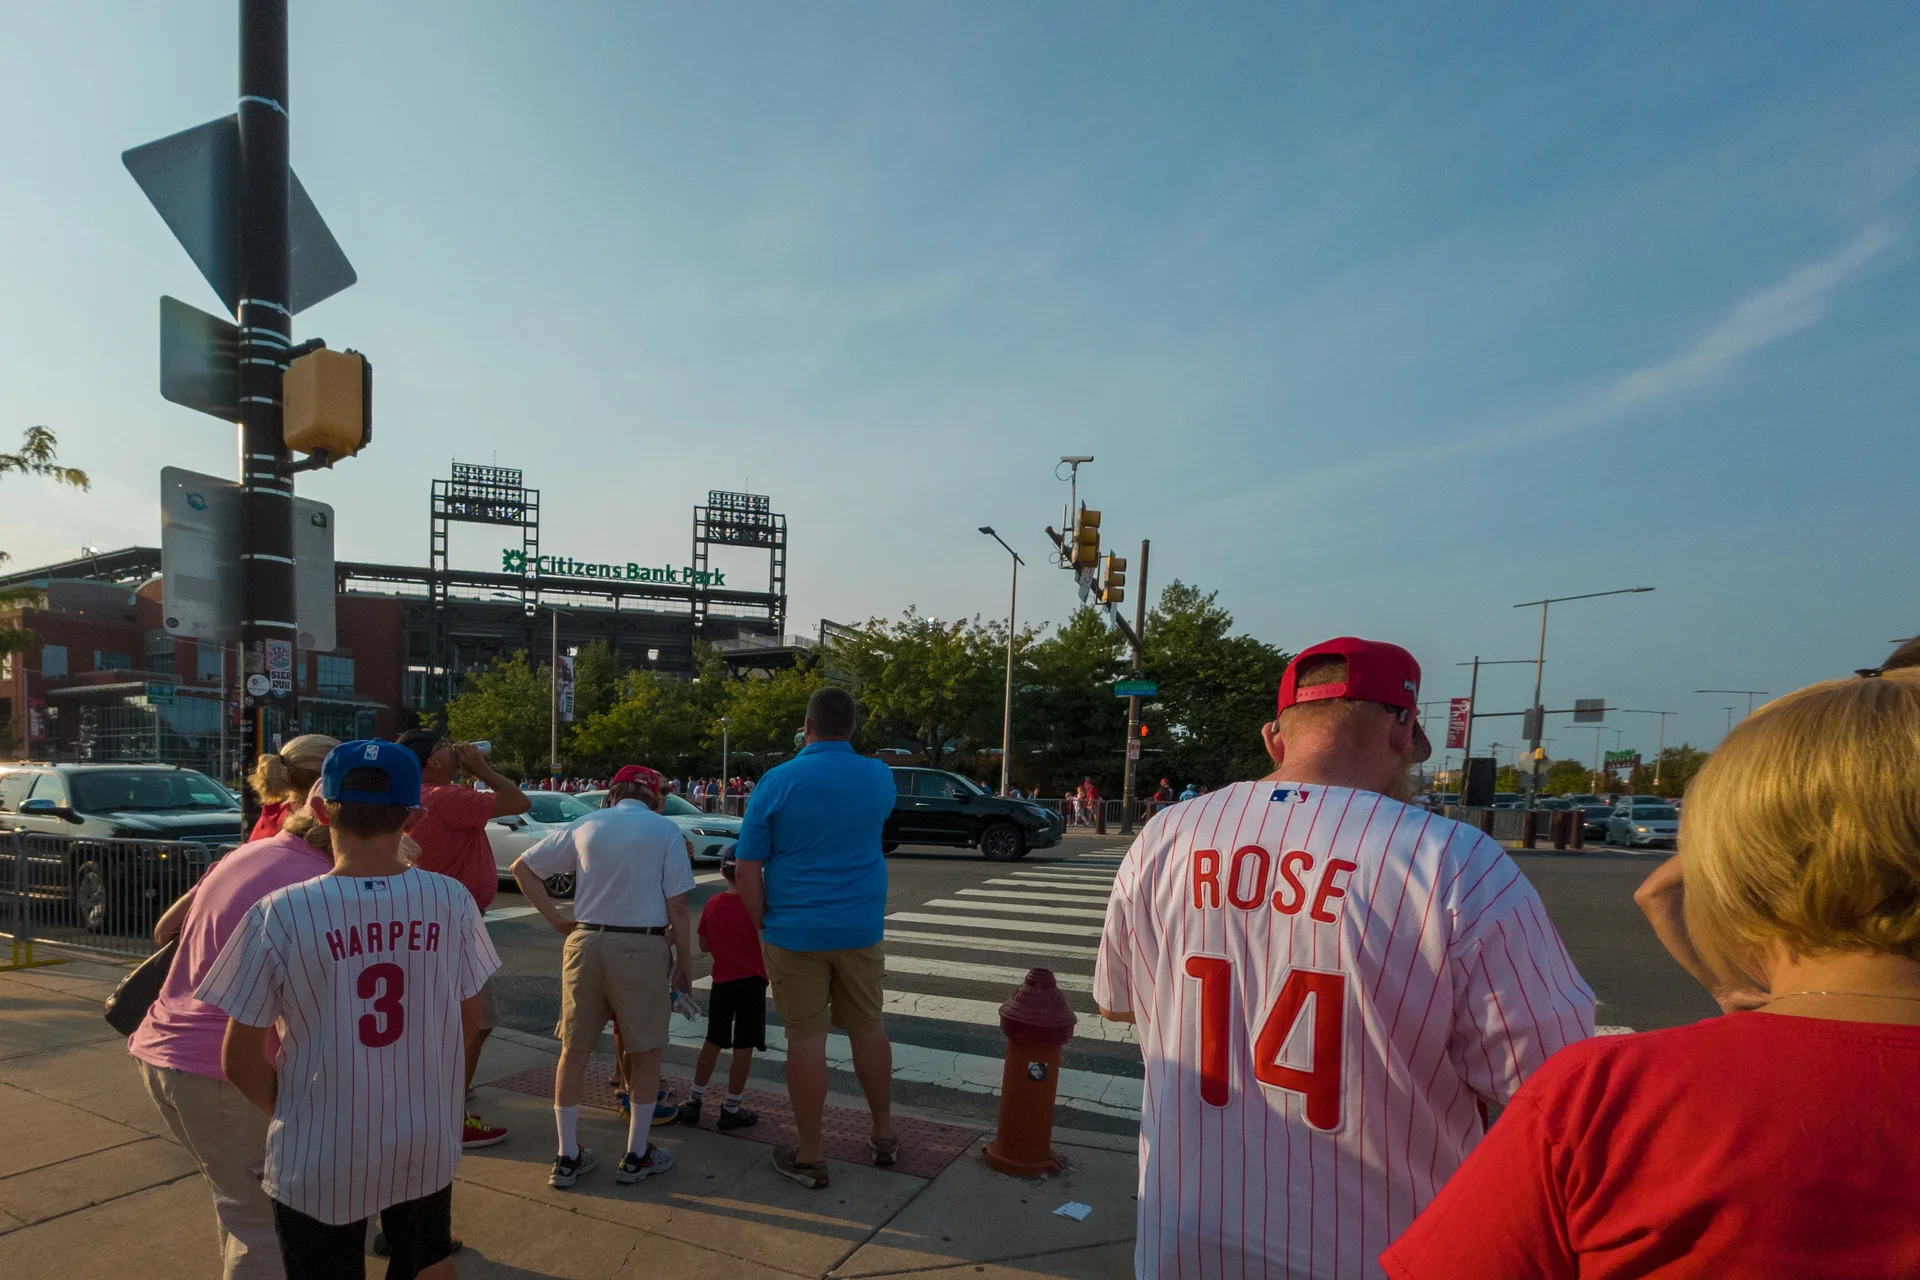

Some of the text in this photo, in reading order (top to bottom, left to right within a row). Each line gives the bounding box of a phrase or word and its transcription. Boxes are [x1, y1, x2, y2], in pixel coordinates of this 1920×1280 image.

[536, 555, 726, 587] Citizens Bank Park
[1193, 844, 1358, 925] ROSE
[325, 920, 440, 961] HARPER
[356, 962, 405, 1048] 3
[1183, 952, 1350, 1133] 14
